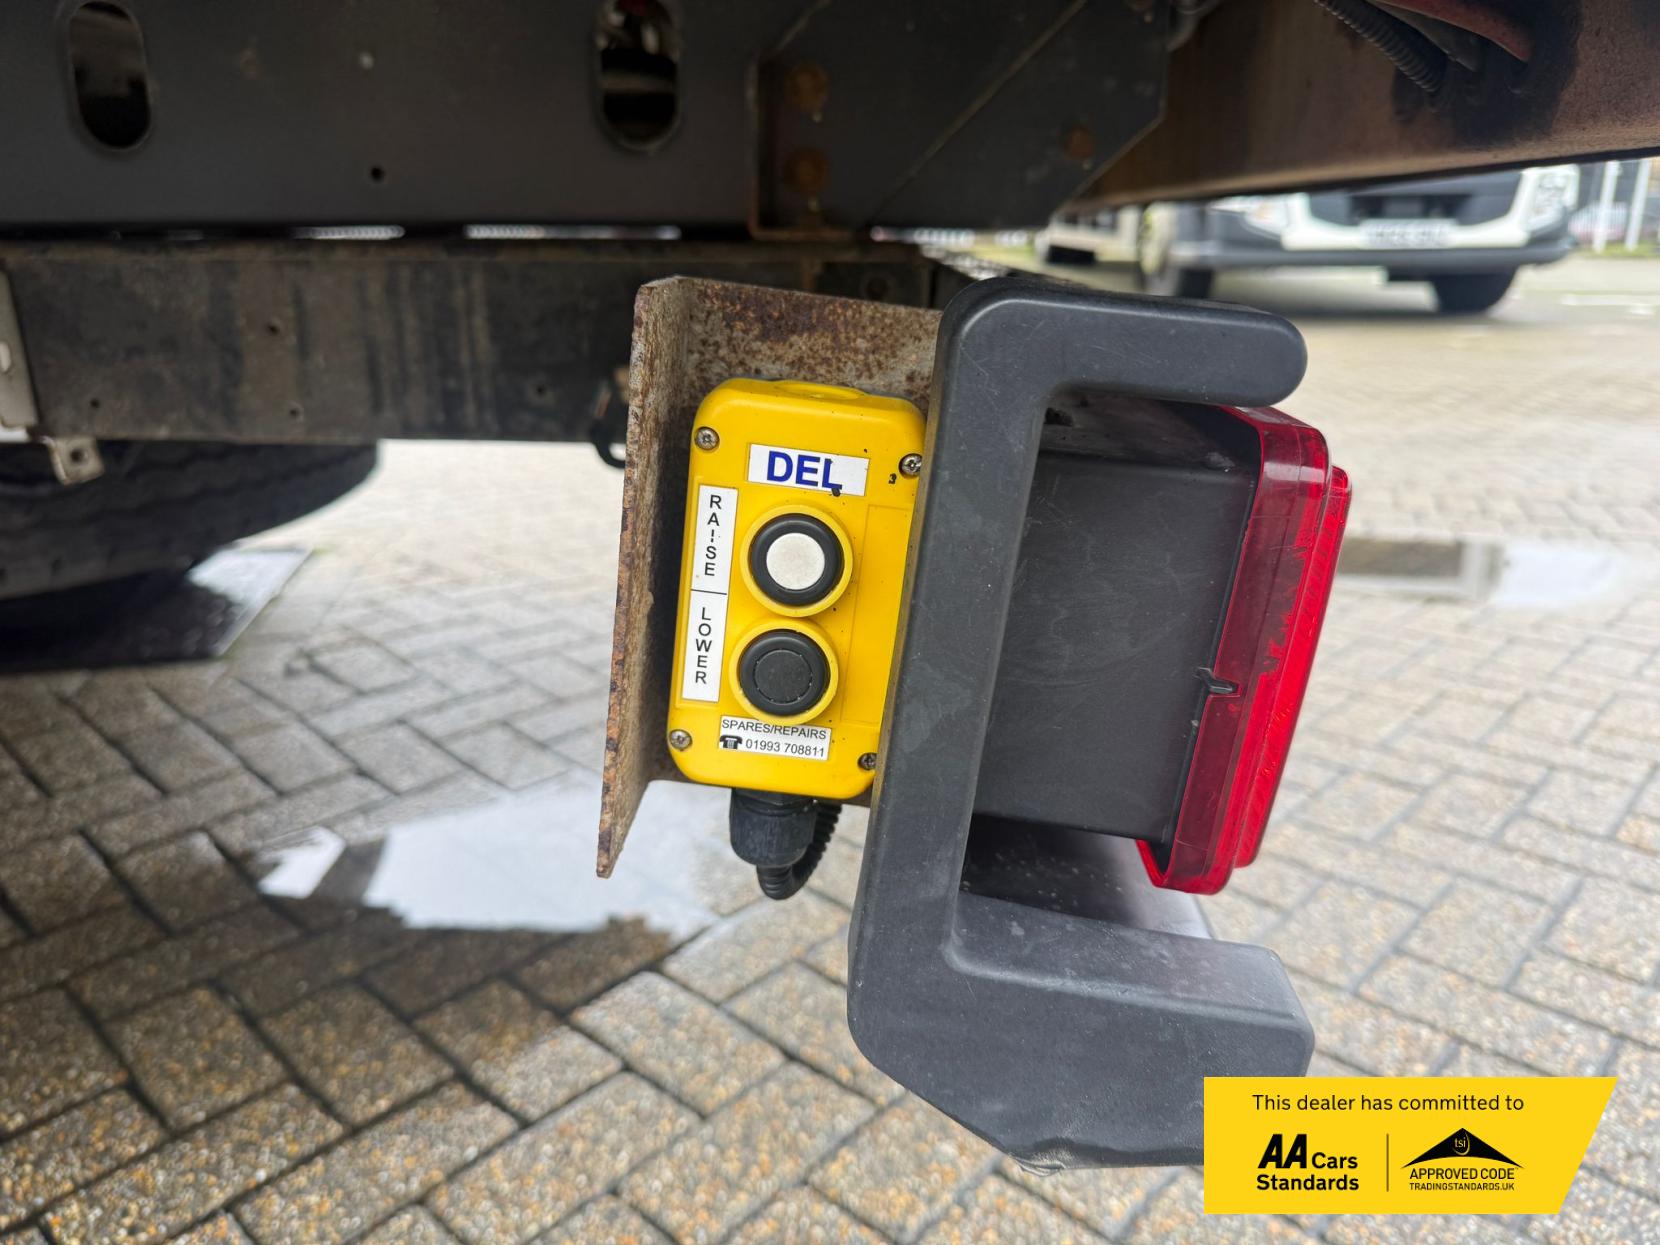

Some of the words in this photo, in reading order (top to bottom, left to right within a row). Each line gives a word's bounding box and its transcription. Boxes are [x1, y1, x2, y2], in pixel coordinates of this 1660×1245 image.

[766, 450, 843, 491] DEL
[704, 494, 722, 577] RAISE
[694, 607, 712, 685] LOWER
[721, 718, 827, 740] SPARES/REPAIRS
[745, 738, 781, 753] 01993
[784, 742, 825, 758] 708811
